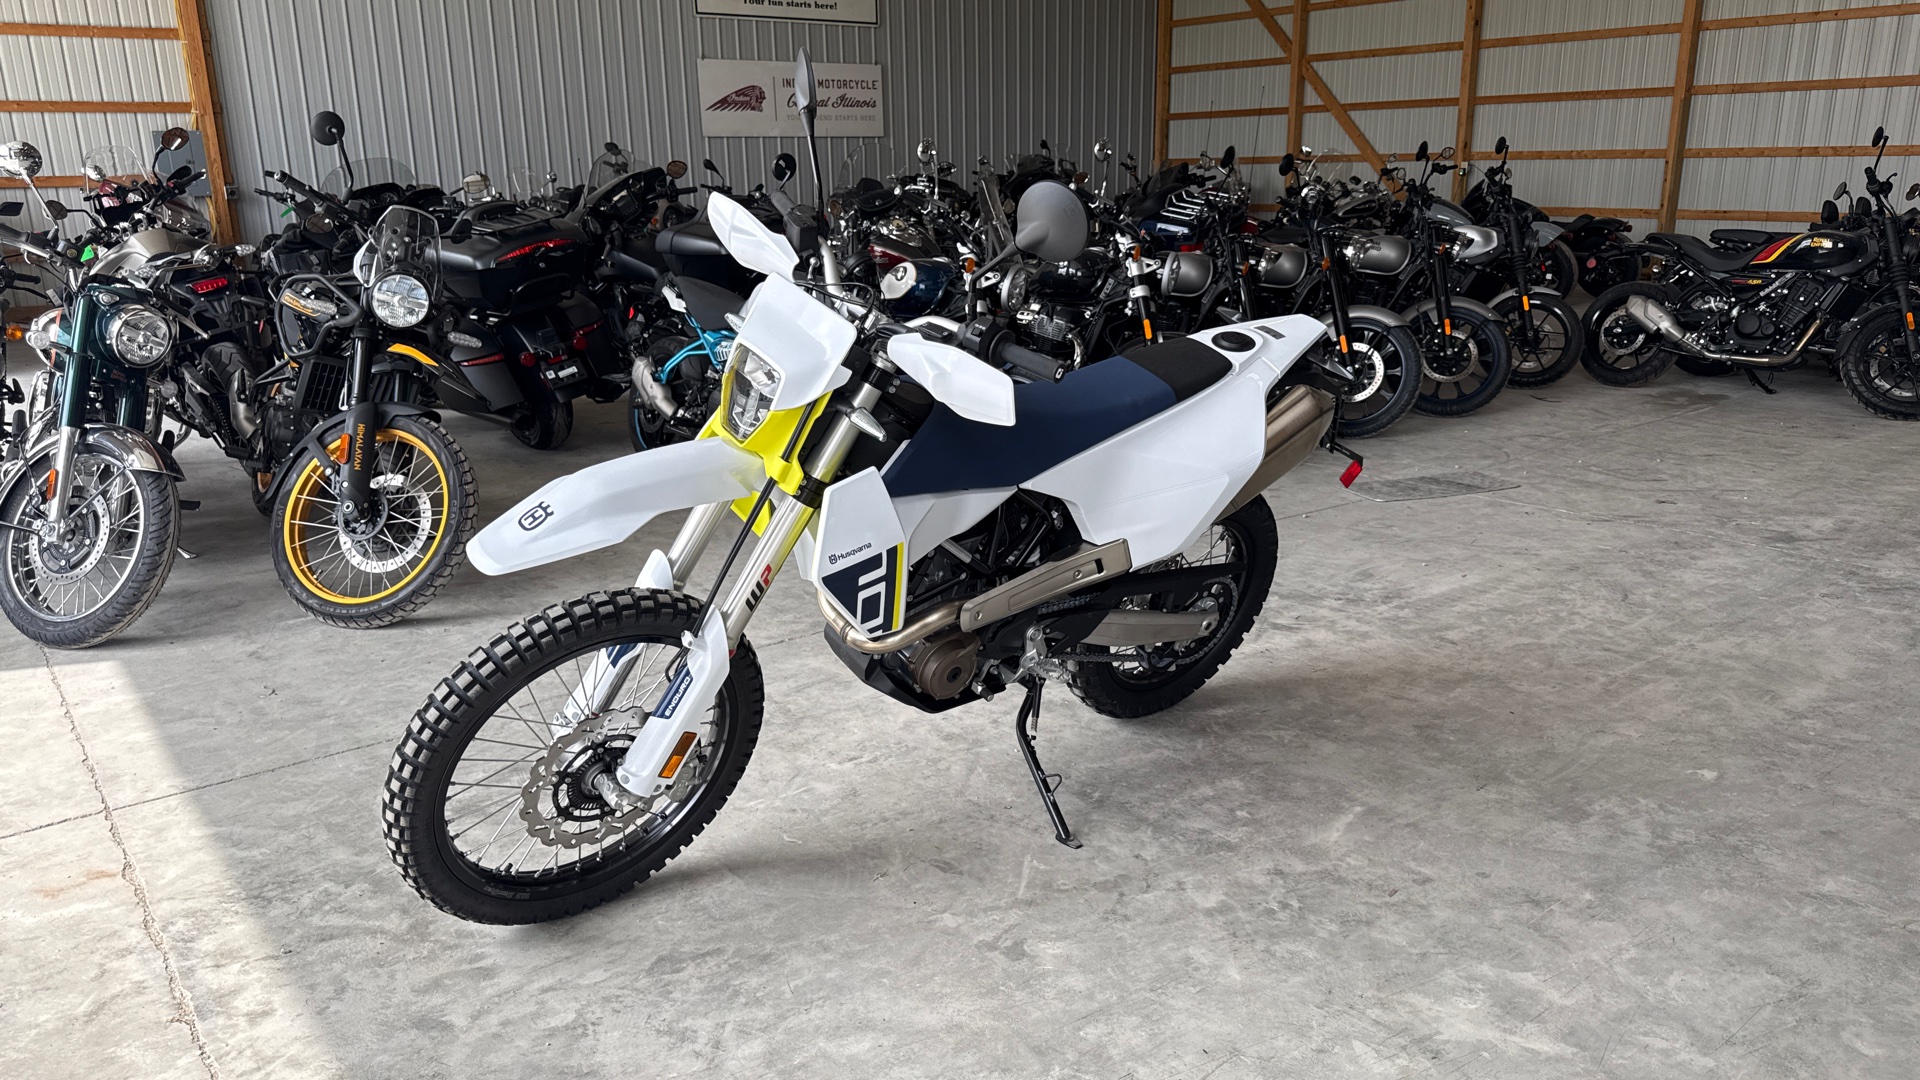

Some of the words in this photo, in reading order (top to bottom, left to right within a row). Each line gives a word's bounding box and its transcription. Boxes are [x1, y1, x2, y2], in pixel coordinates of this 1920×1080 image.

[814, 1, 837, 10] here!
[817, 79, 878, 90] MOTORCYCLE
[831, 93, 877, 108] Illinois
[354, 423, 365, 470] HIMALAYAN
[450, 500, 458, 525] CEAT
[837, 542, 872, 560] Husqvarna
[745, 563, 772, 612] WP
[664, 676, 691, 717] ENDURO
